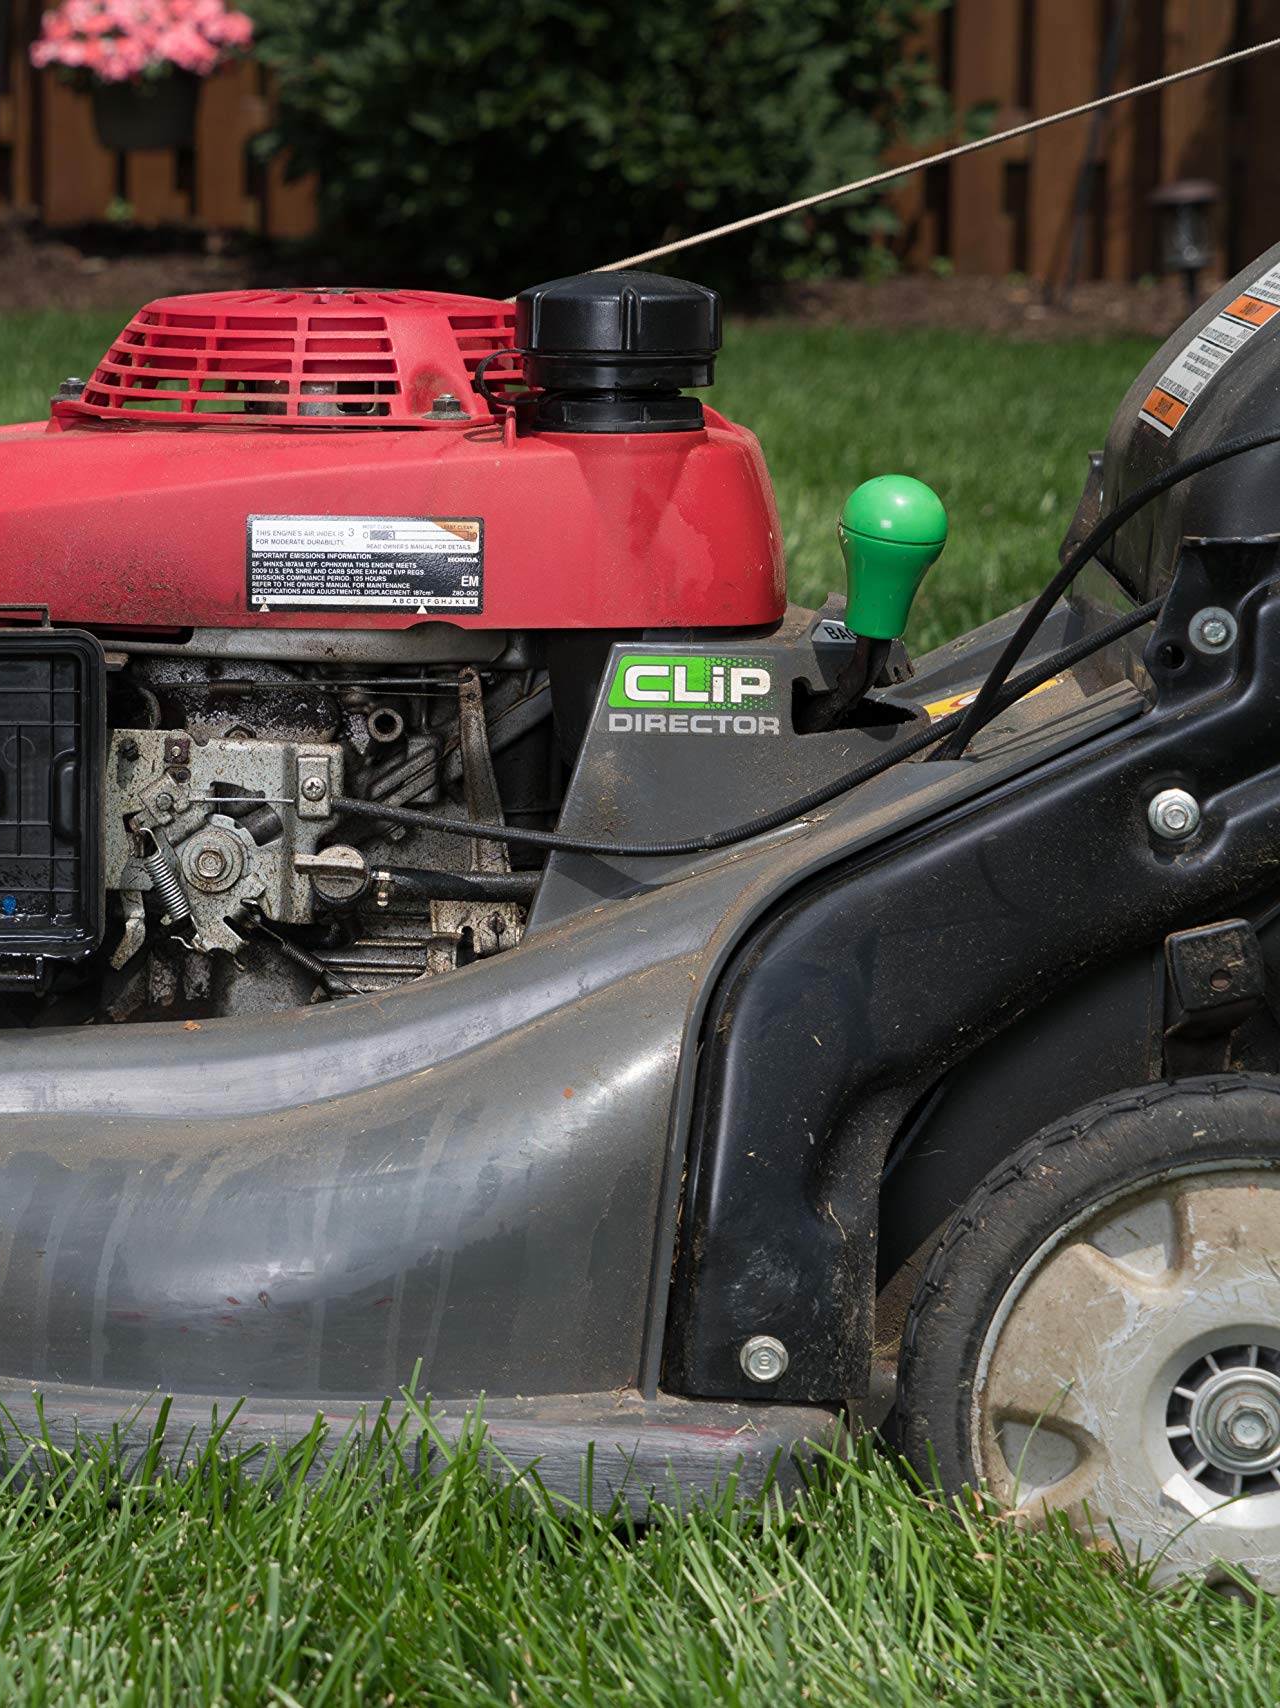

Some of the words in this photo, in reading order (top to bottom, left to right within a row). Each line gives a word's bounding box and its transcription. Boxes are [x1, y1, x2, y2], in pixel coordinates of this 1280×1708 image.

[348, 528, 355, 537] 3
[388, 532, 394, 540] 3
[461, 576, 479, 586] EM
[608, 713, 780, 736] DIRECTOR
